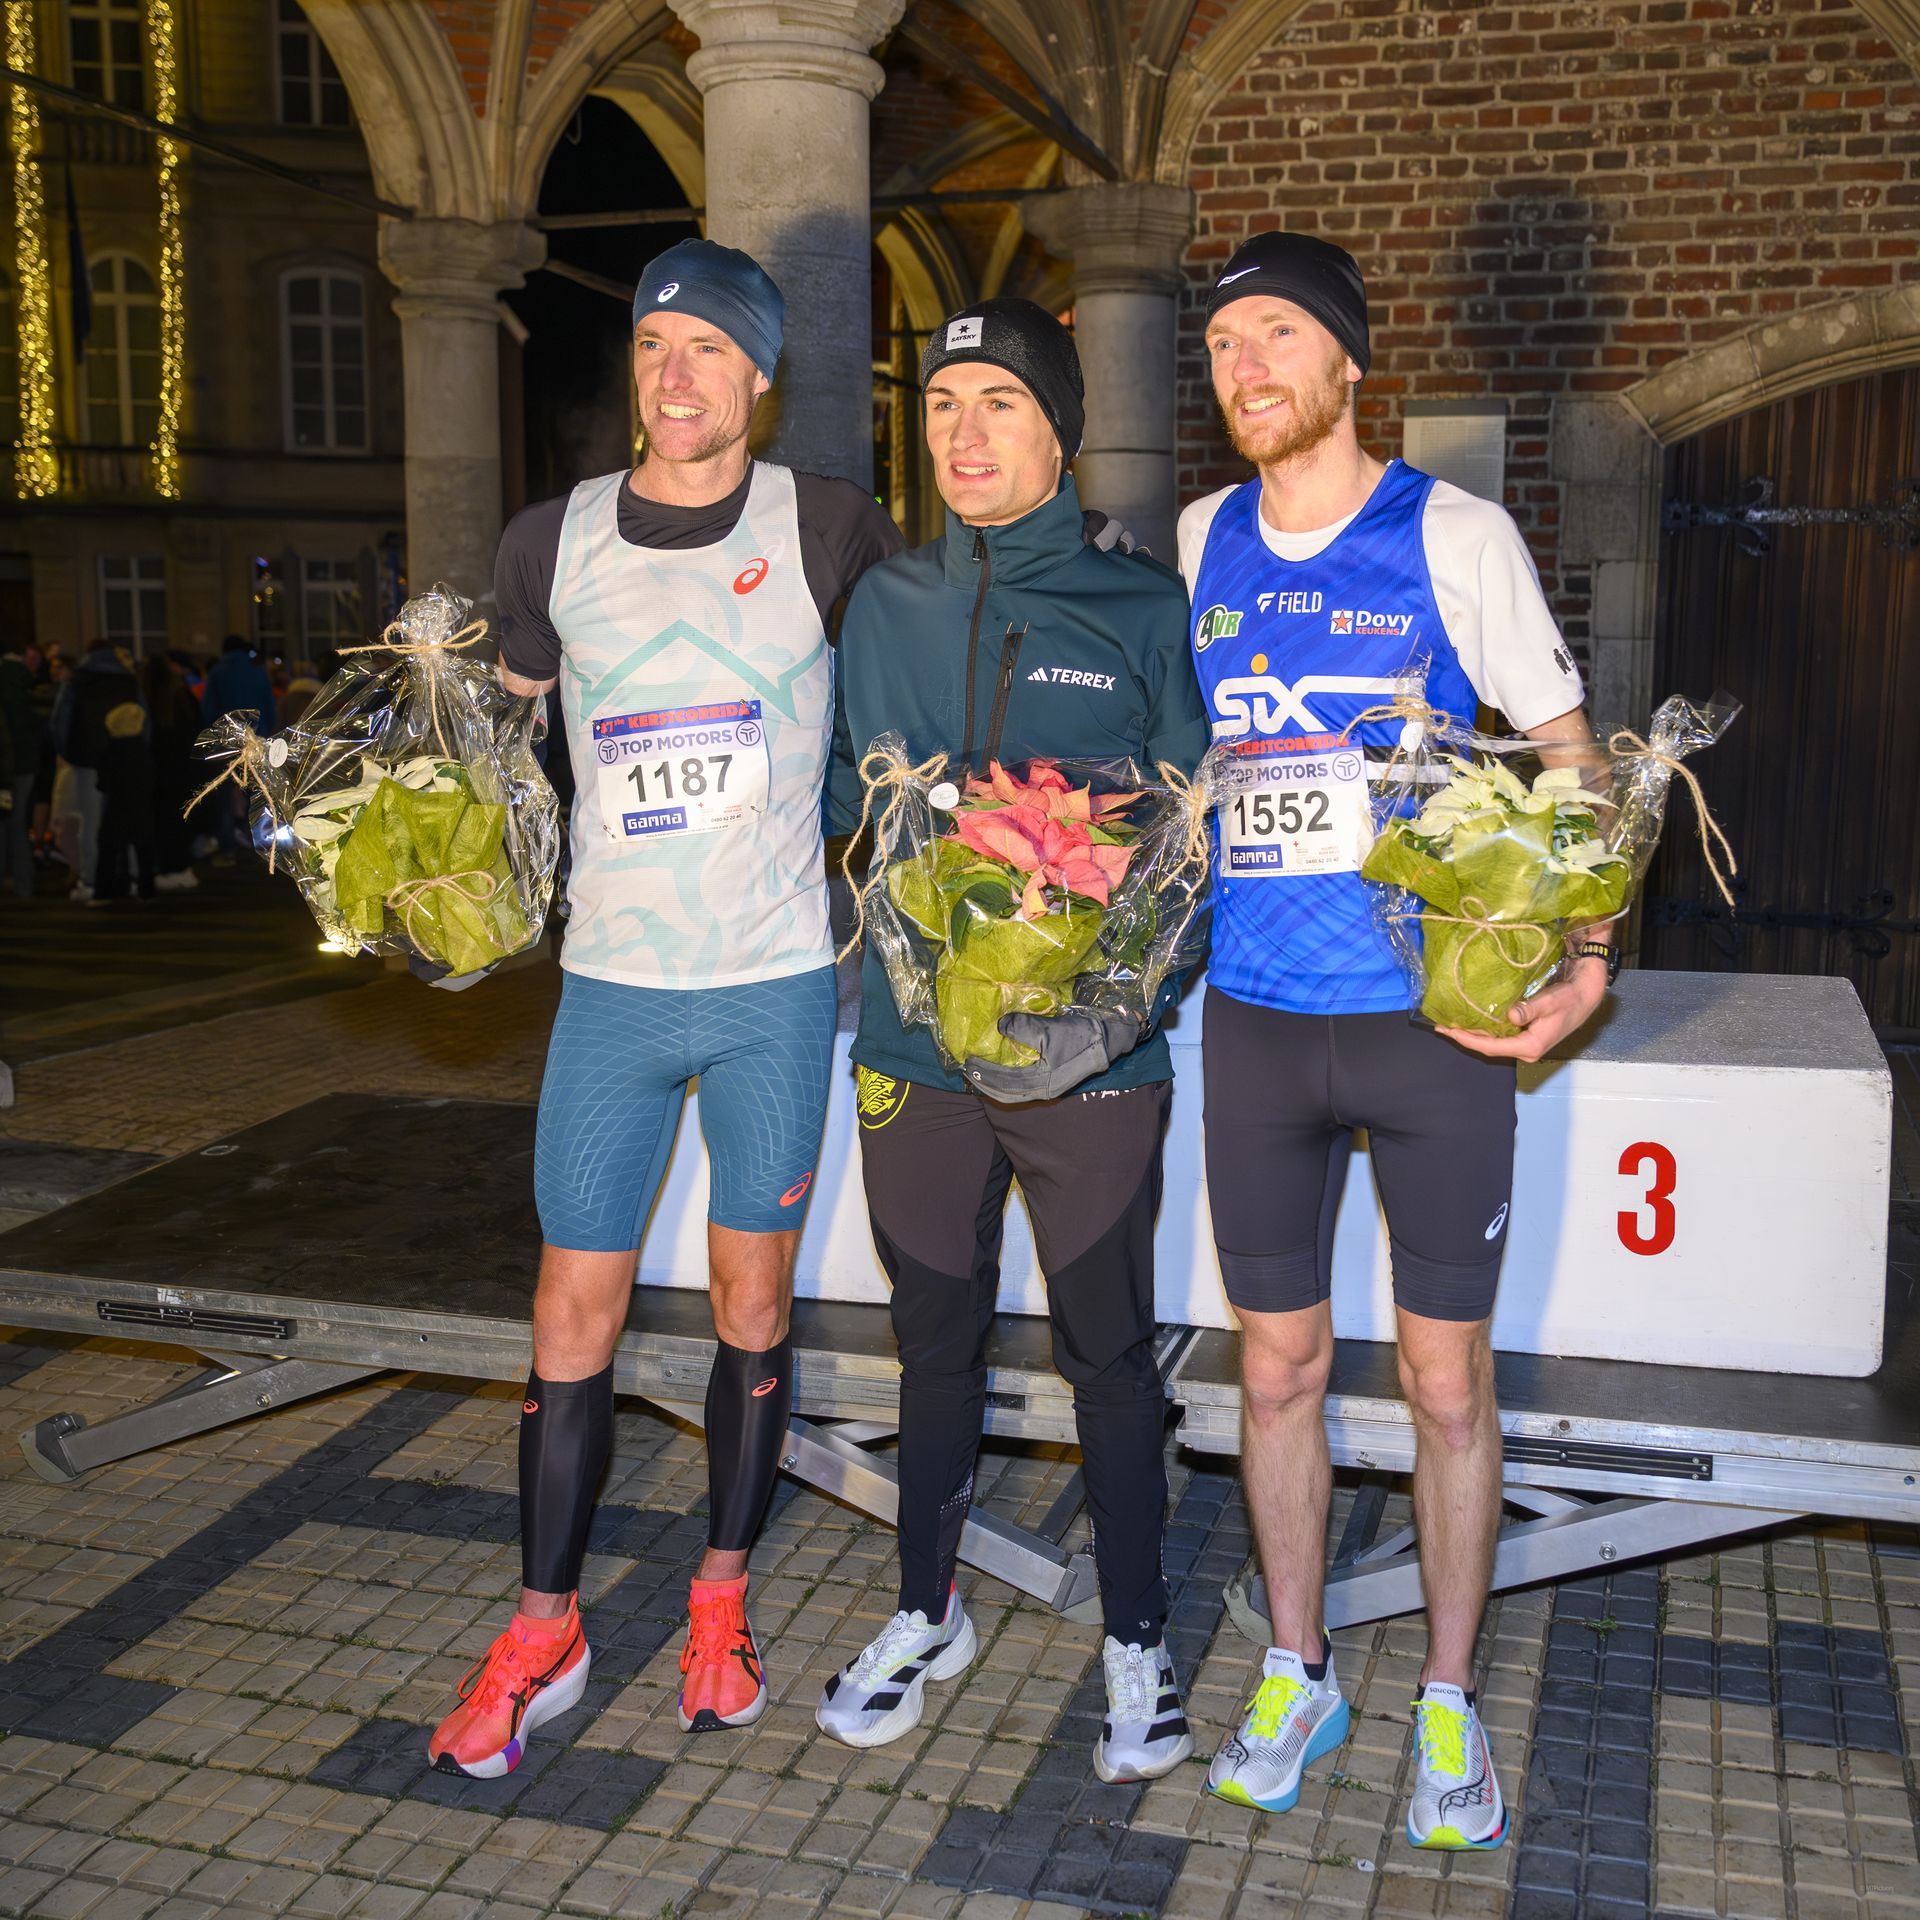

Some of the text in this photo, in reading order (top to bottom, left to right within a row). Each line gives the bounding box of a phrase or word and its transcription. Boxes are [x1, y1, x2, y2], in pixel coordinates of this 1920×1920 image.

[951, 334, 977, 343] SAYSKY
[1195, 604, 1243, 652] AVR
[1355, 610, 1414, 636] Dovy
[1355, 626, 1400, 636] KEUKENS
[1050, 667, 1116, 691] TERREX
[628, 703, 751, 729] KERSTCORRIDA
[620, 729, 733, 755] TOP MOTORS
[627, 754, 733, 803] 1187
[1257, 763, 1328, 782] MOTORS
[1234, 790, 1333, 836] 1552
[1617, 1141, 1677, 1256] 3
[1429, 1687, 1461, 1697] saucony
